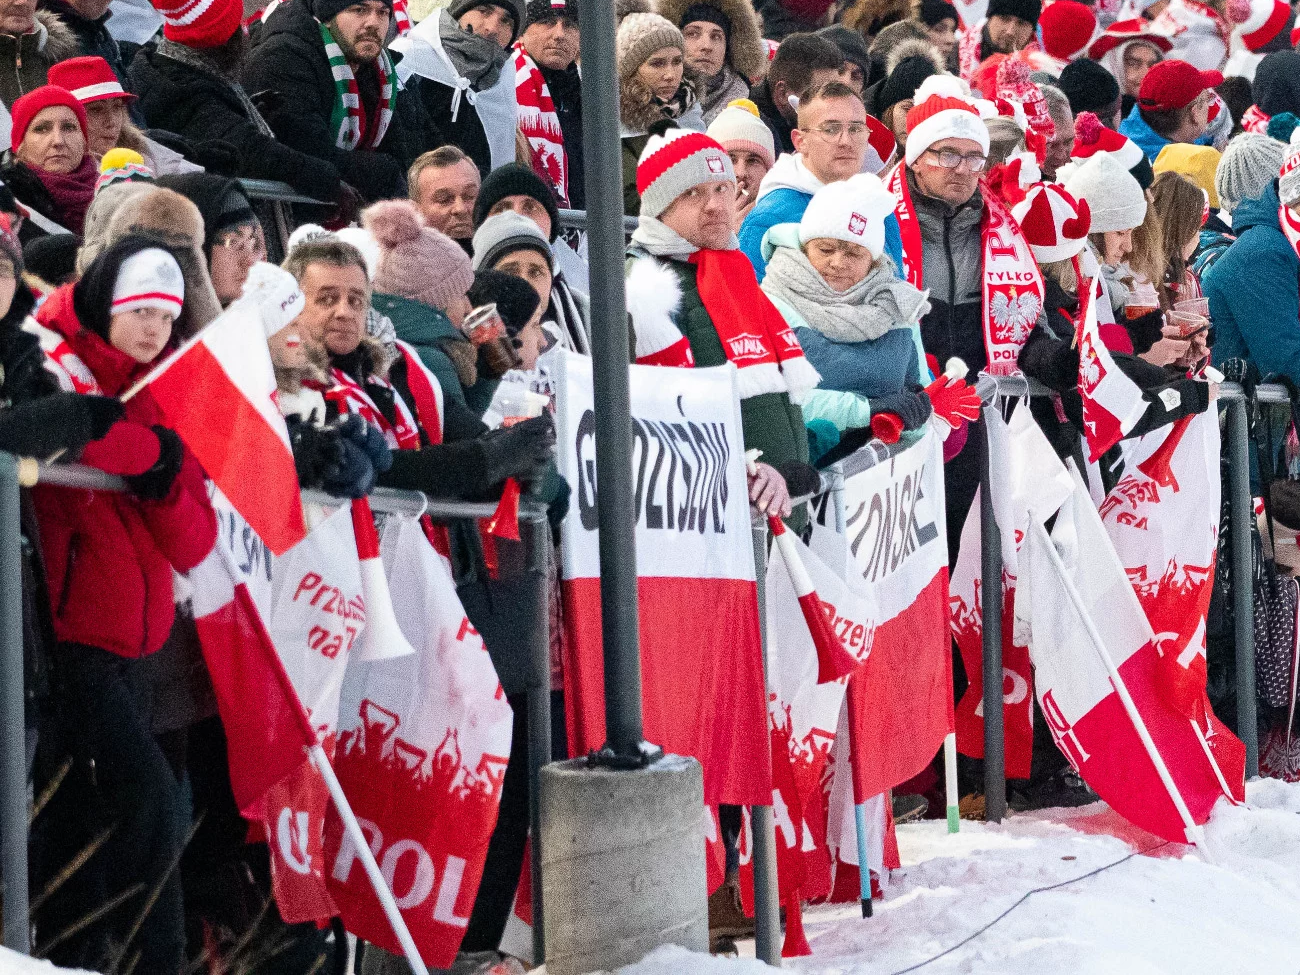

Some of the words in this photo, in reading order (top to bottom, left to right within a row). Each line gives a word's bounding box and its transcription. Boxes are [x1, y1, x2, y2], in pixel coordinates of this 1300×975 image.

[281, 292, 300, 311] POL
[987, 271, 1034, 282] TYLKO
[575, 394, 730, 536] GDZISZÓW
[332, 815, 468, 926] POL
